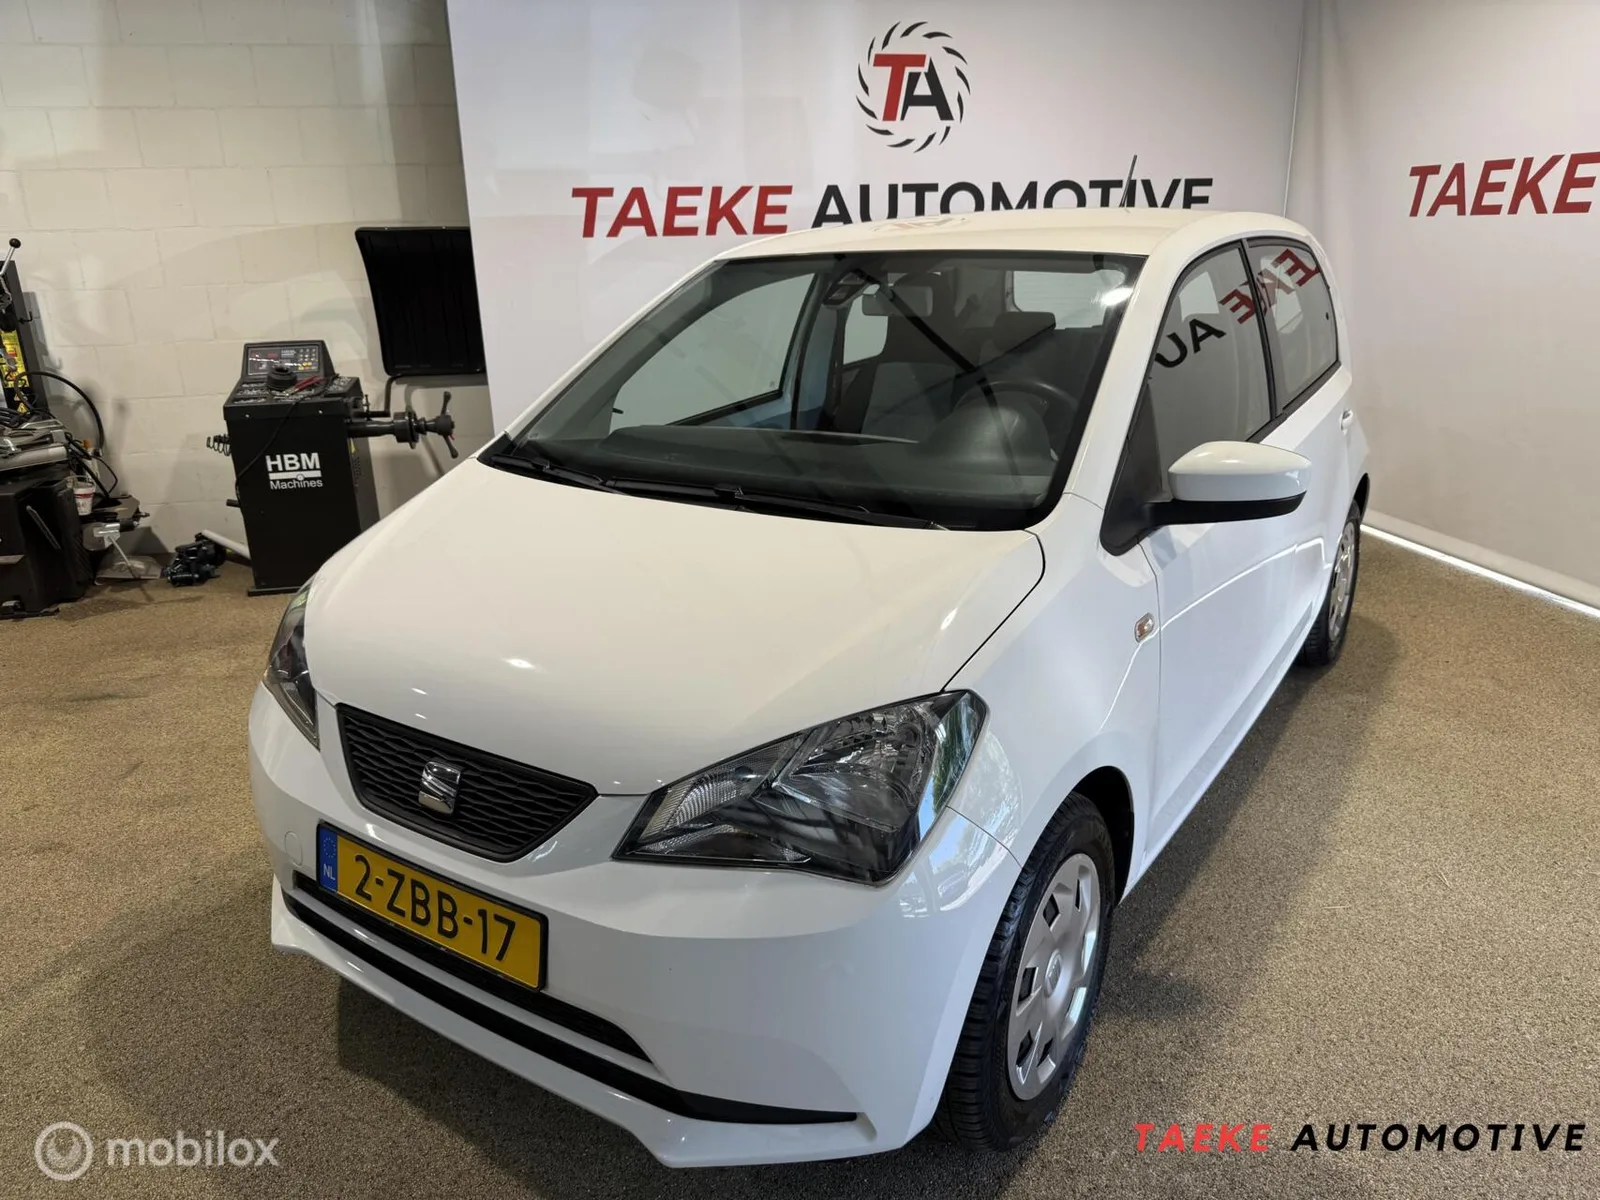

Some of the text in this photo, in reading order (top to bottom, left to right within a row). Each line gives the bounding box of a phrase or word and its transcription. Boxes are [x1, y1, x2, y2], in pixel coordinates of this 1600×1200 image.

[873, 53, 954, 121] TA
[571, 178, 1213, 238] TAEKE AUTOMOTIVE
[1409, 152, 1600, 217] TAEKE
[265, 452, 320, 472] HBM
[269, 479, 324, 490] Machines
[323, 863, 336, 881] NL
[355, 854, 516, 962] 2-ZBB-17
